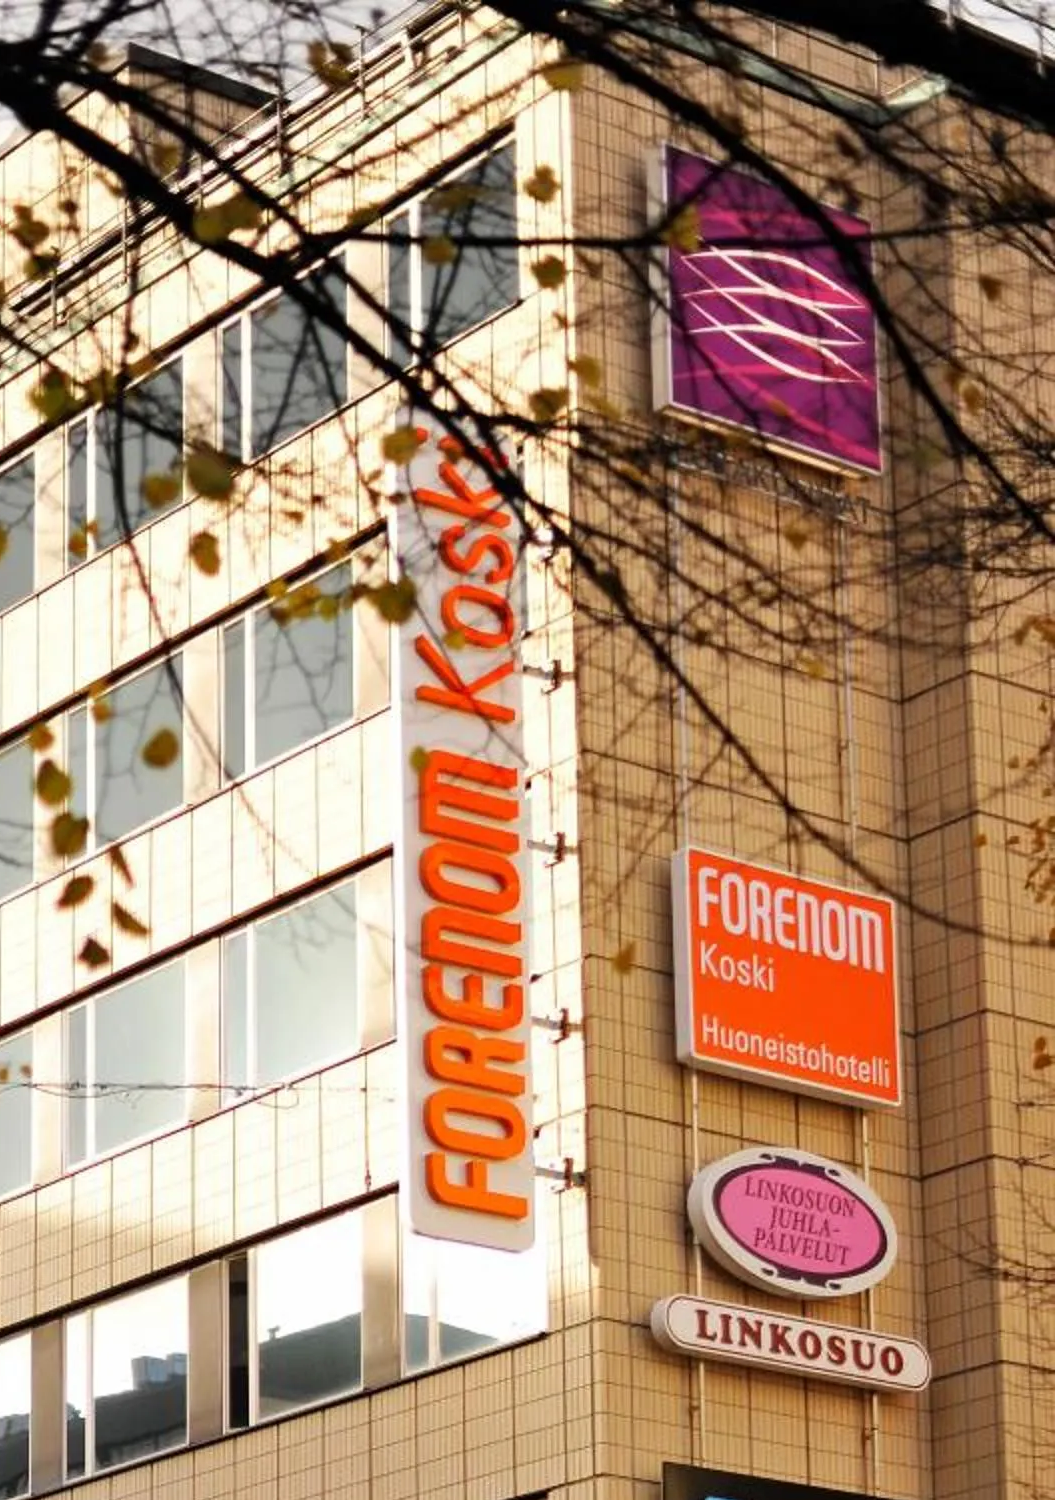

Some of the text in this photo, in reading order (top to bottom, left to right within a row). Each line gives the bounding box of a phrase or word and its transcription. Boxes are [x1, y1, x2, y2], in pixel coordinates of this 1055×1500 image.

[698, 866, 885, 974] FORENOM
[418, 748, 530, 1221] FORENOM
[700, 940, 775, 993] Koski
[701, 1013, 891, 1089] Huoneistohotelli
[744, 1175, 857, 1217] LINKOSUON
[769, 1205, 841, 1238] JUHLA-
[753, 1227, 851, 1266] PALVELUT
[695, 1308, 905, 1378] LINKOSUO
